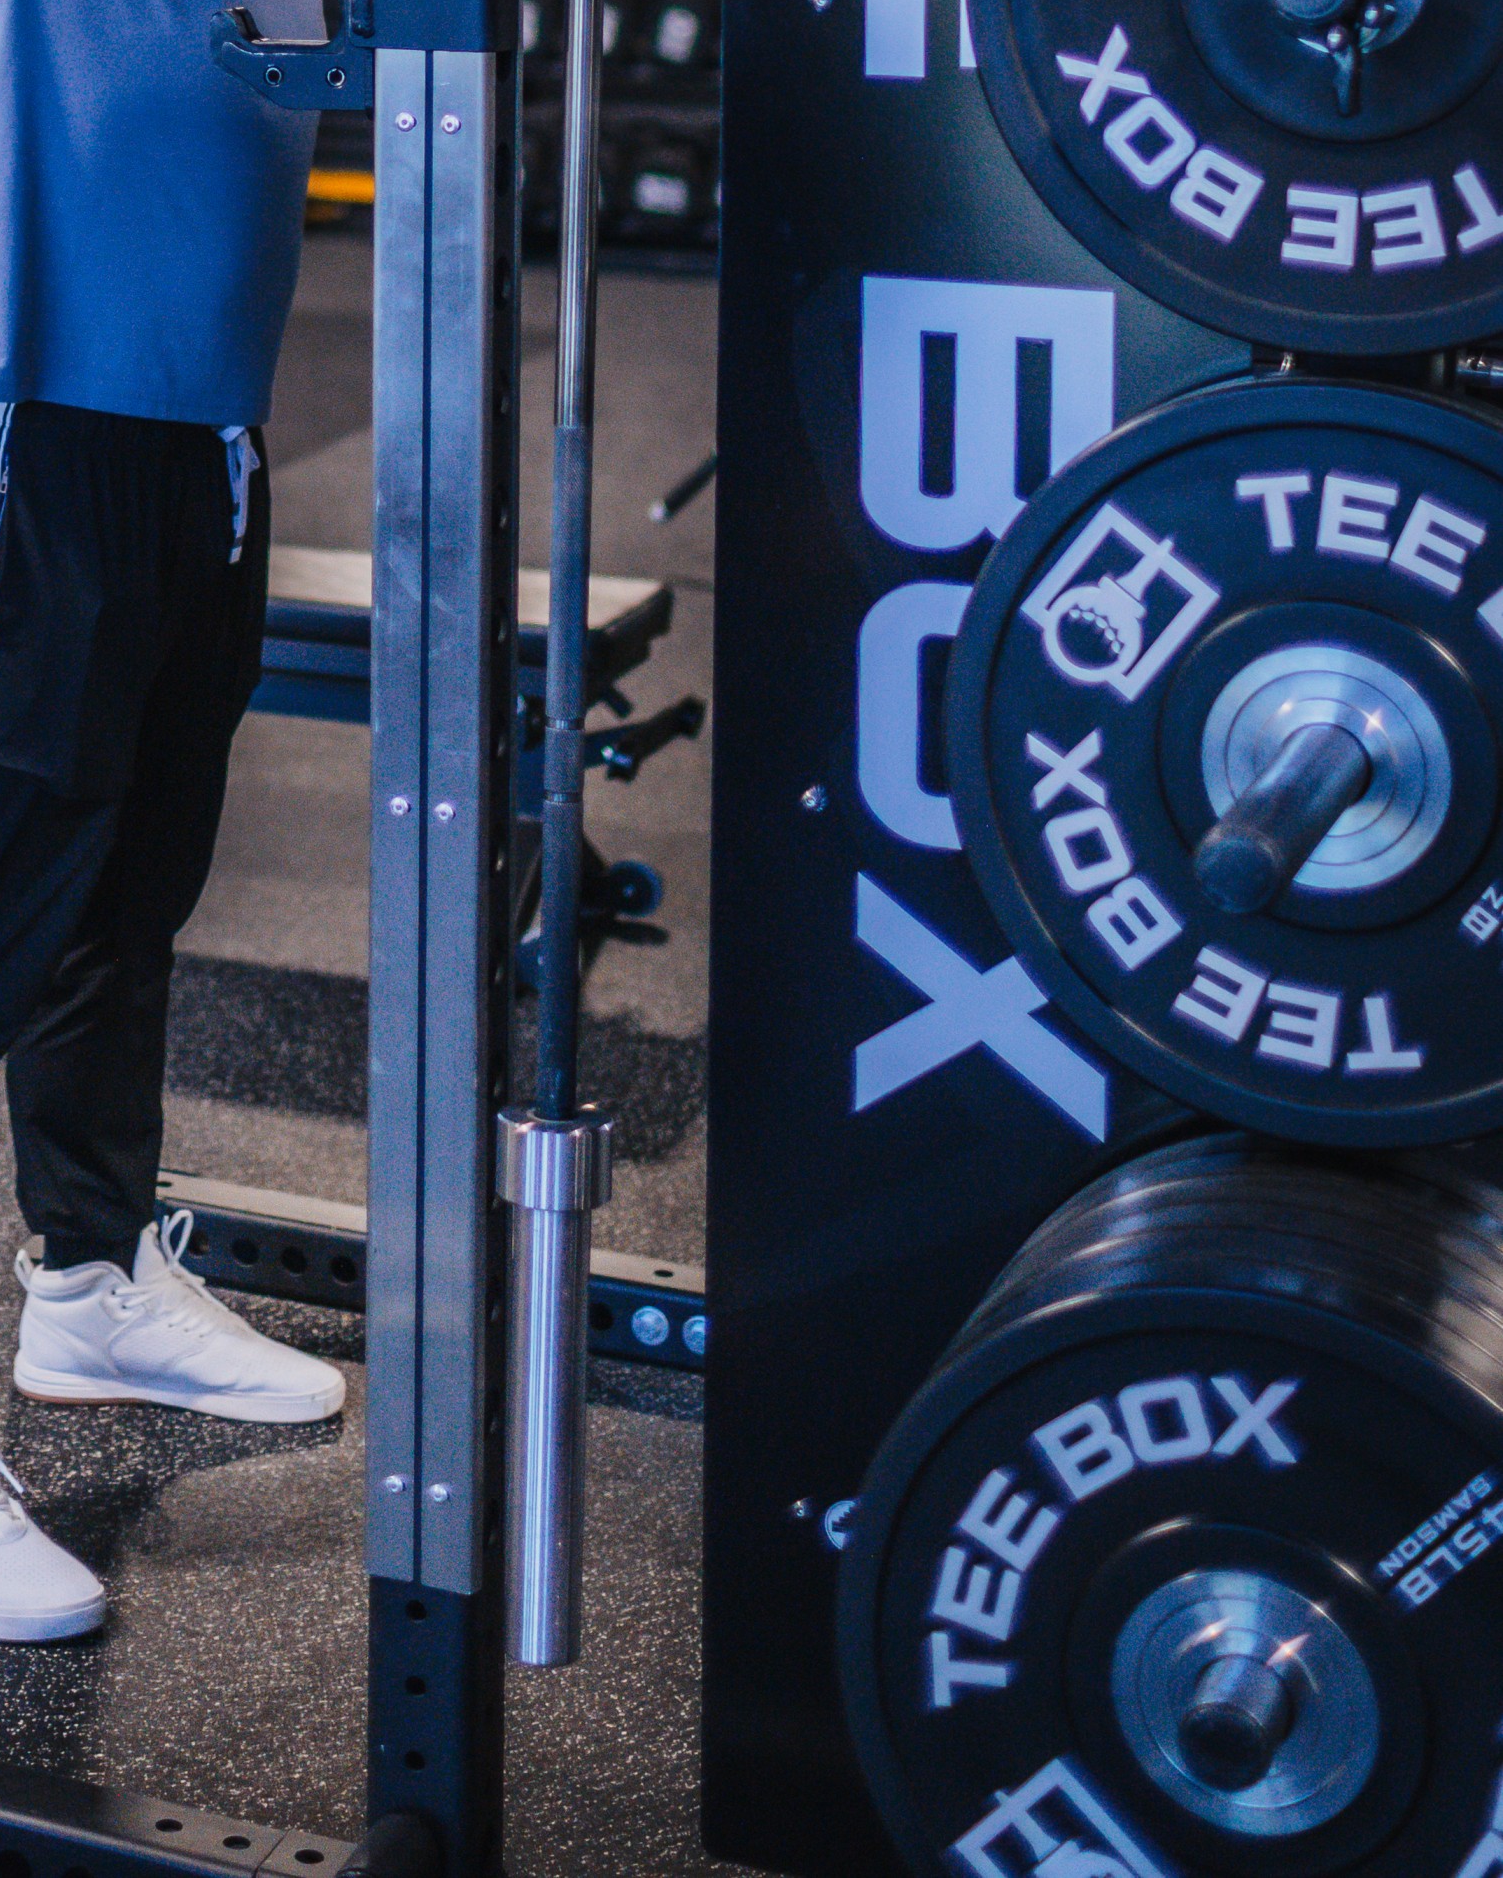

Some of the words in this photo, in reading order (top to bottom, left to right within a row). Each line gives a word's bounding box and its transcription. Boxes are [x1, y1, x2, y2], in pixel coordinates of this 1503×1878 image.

[1055, 25, 1265, 243] BOX
[1236, 474, 1486, 593] TEE
[1026, 729, 1182, 971] BOX
[1172, 946, 1423, 1074] TEE
[928, 1469, 1061, 1709] TEE
[1033, 1374, 1298, 1502] BOX
[1378, 1474, 1493, 1577] SAMSON
